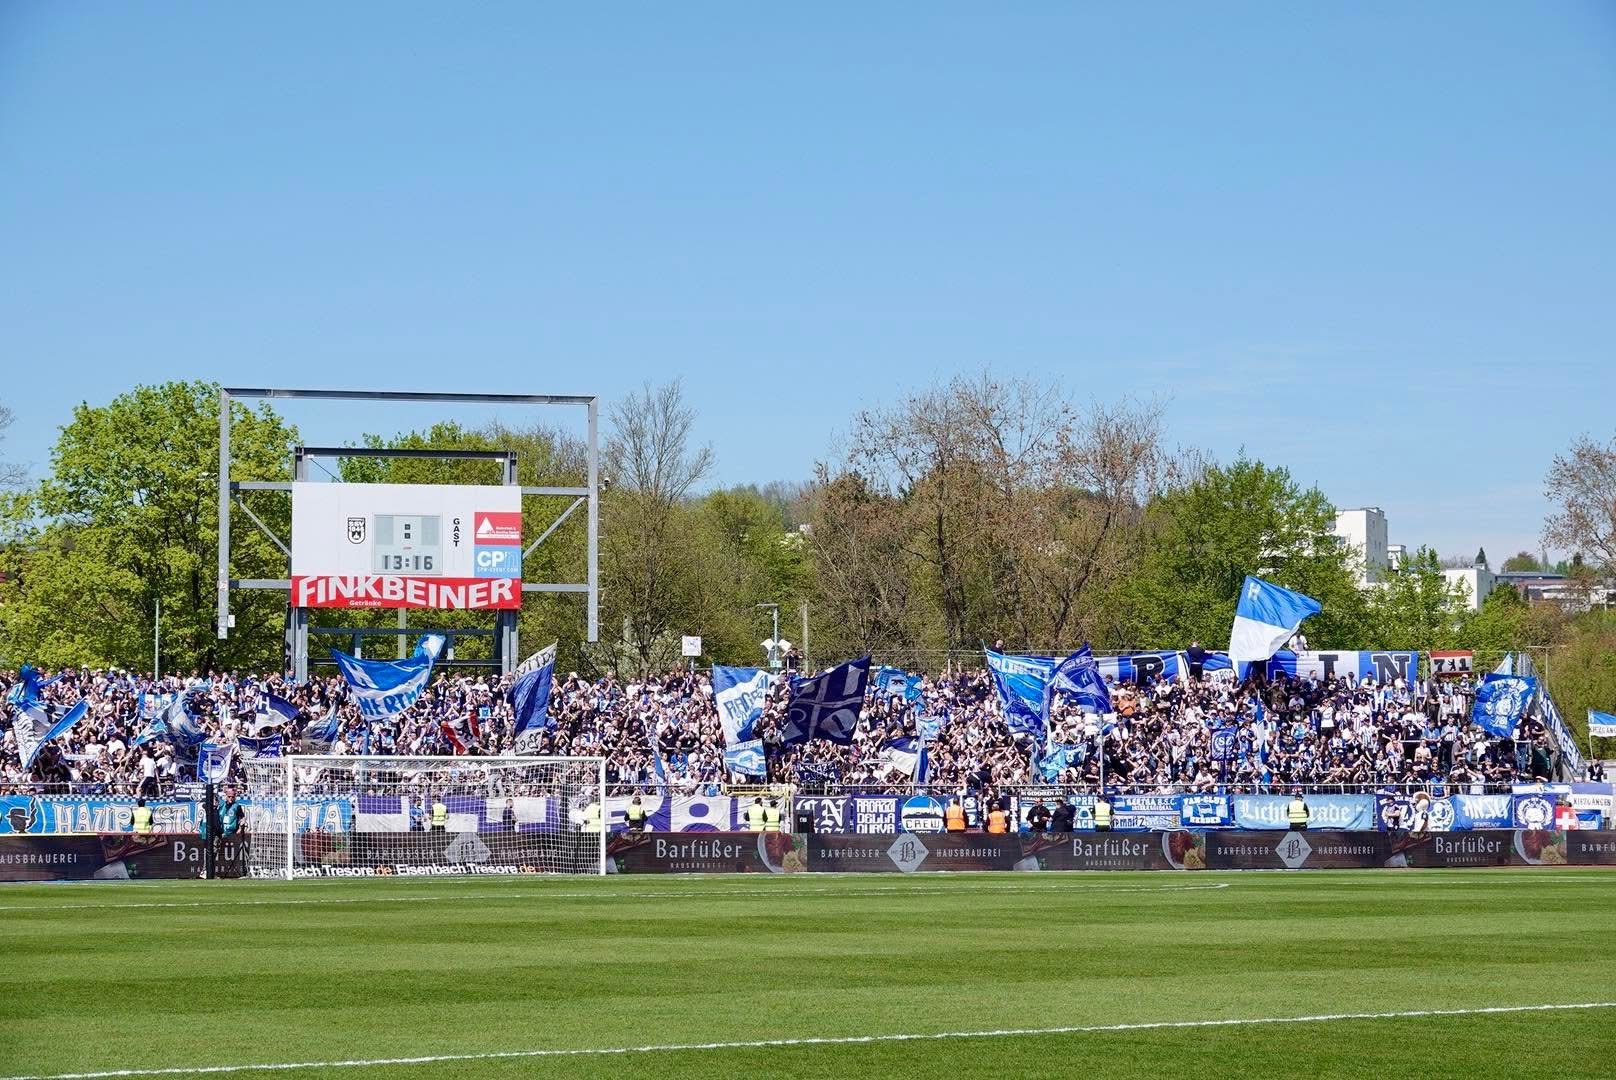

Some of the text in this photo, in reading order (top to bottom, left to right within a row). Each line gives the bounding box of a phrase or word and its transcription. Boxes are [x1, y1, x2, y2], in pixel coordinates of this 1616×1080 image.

[384, 555, 433, 570] 13:16
[299, 576, 513, 608] FINKBEINER
[906, 820, 939, 829] CREW
[656, 839, 742, 858] Barfüßer
[821, 846, 880, 858] BARFÜSSER
[936, 848, 1001, 858] HAUSBRAUEREI
[1073, 838, 1149, 857] Barfüßer
[1217, 845, 1270, 855] BARFÜSSER
[1318, 846, 1375, 855] HAUSBRAUEREI
[1435, 836, 1501, 854] Barfüßer
